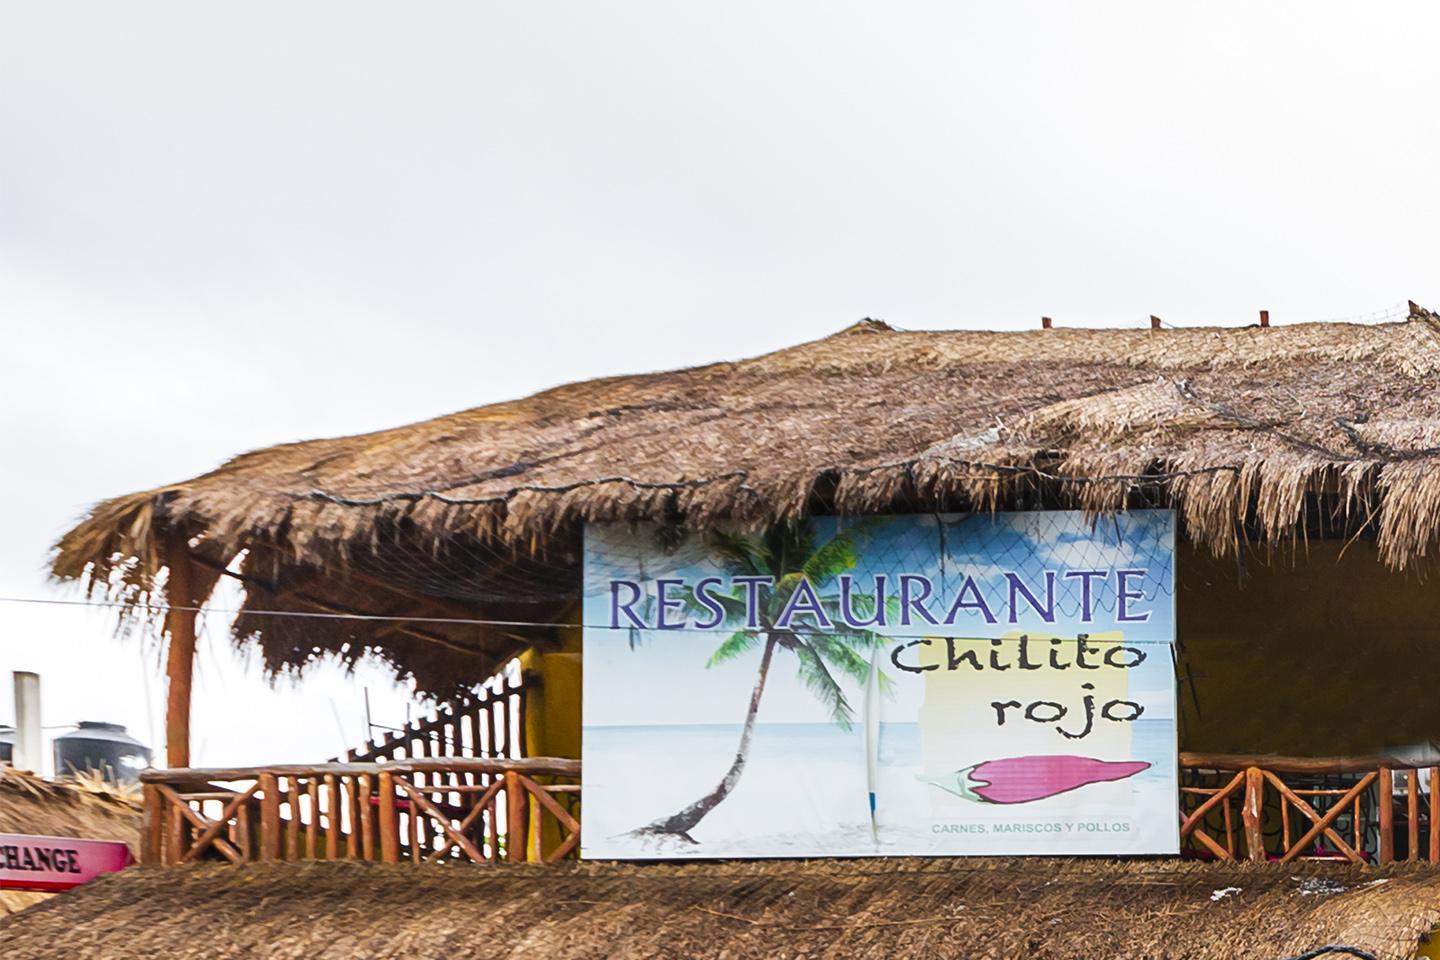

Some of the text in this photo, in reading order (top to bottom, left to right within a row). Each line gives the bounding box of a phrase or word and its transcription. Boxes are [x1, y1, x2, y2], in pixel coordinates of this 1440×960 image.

[608, 567, 1152, 632] RESTAURANTE
[890, 634, 1148, 673] Chilito
[991, 683, 1145, 739] rojo
[931, 822, 1130, 834] CARNES, MARISCOS Y POLLOS
